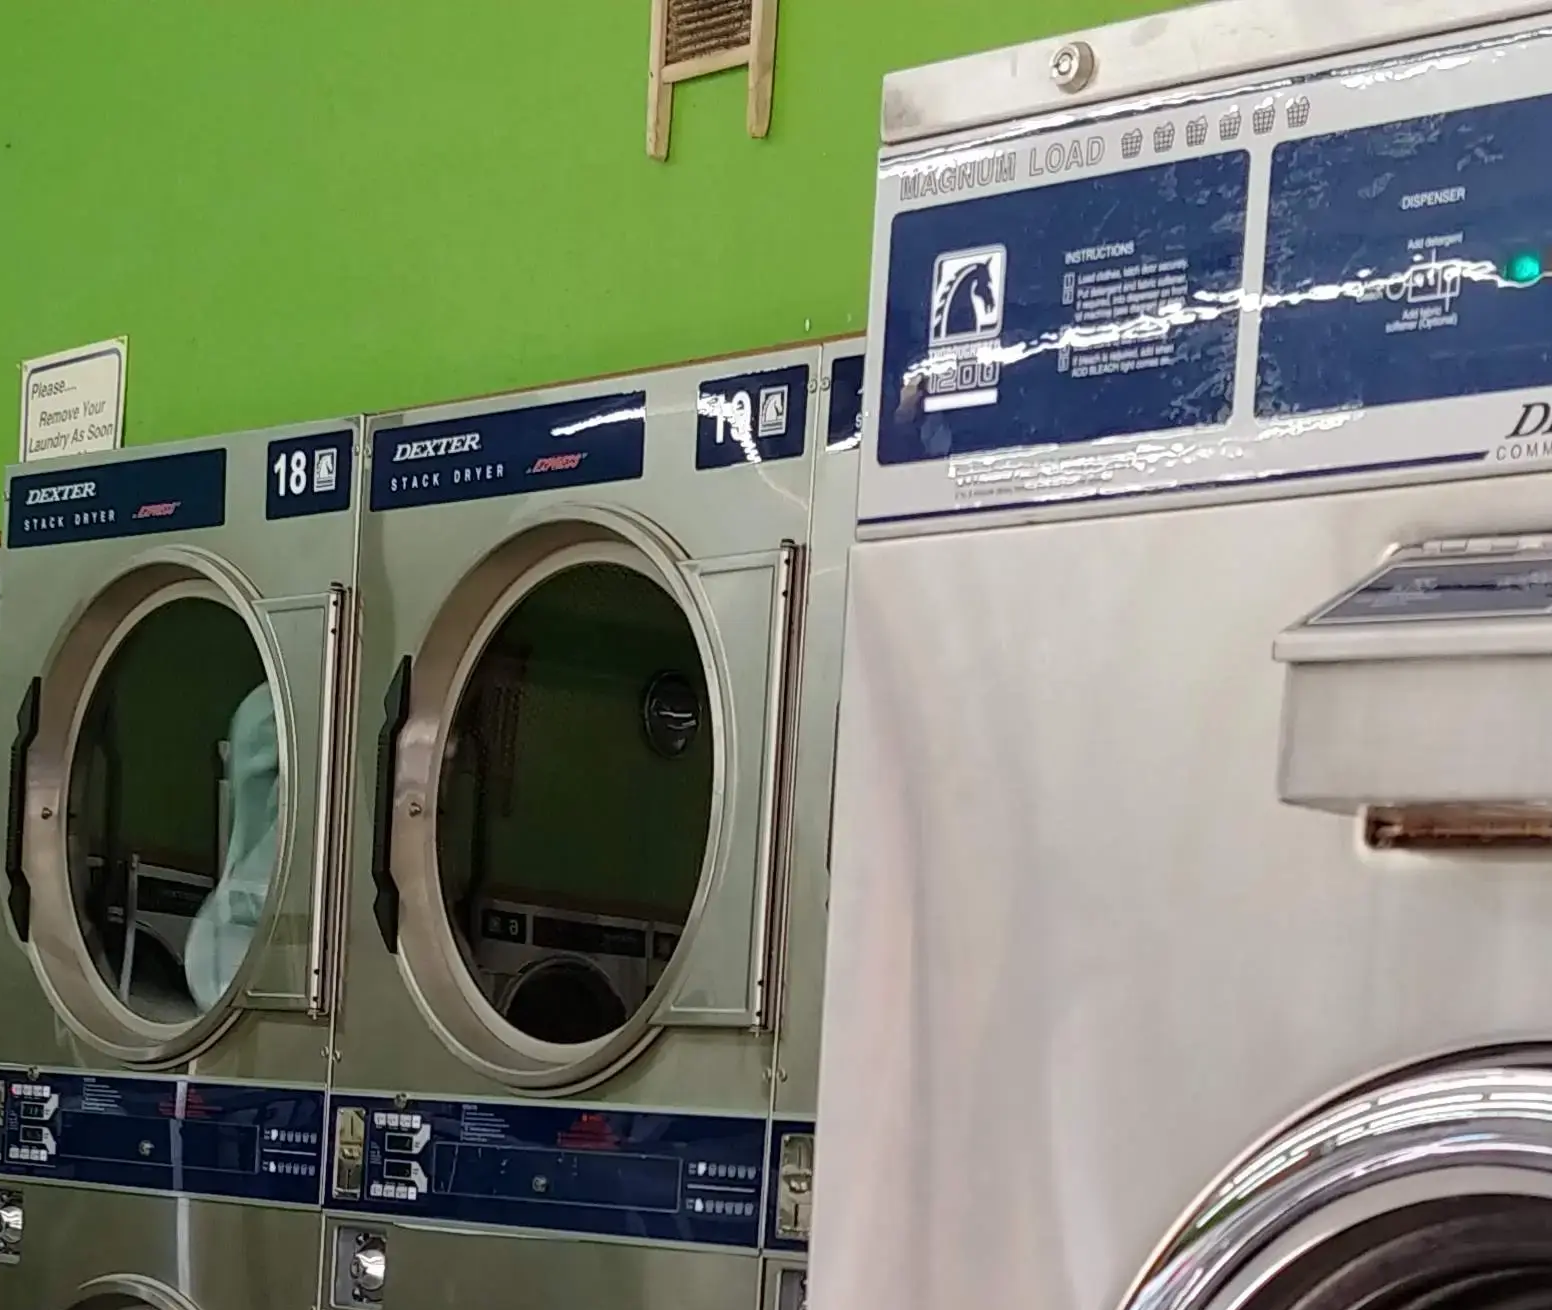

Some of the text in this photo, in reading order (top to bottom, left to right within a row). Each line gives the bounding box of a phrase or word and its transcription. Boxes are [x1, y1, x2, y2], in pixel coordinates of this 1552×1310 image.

[899, 136, 1105, 201] MAGNUM LOAD
[1401, 186, 1466, 210] DISPENSER
[1065, 240, 1134, 264] INSTRUCTIONS
[39, 400, 106, 428] Remove Your
[712, 390, 751, 443] 19
[28, 423, 114, 453] Laundry As Soon
[392, 432, 481, 462] DEXTER
[274, 451, 307, 496] 18
[391, 464, 504, 491] STACK DRYER
[25, 482, 96, 505] DEXTER
[24, 510, 116, 532] STACK DRYER
